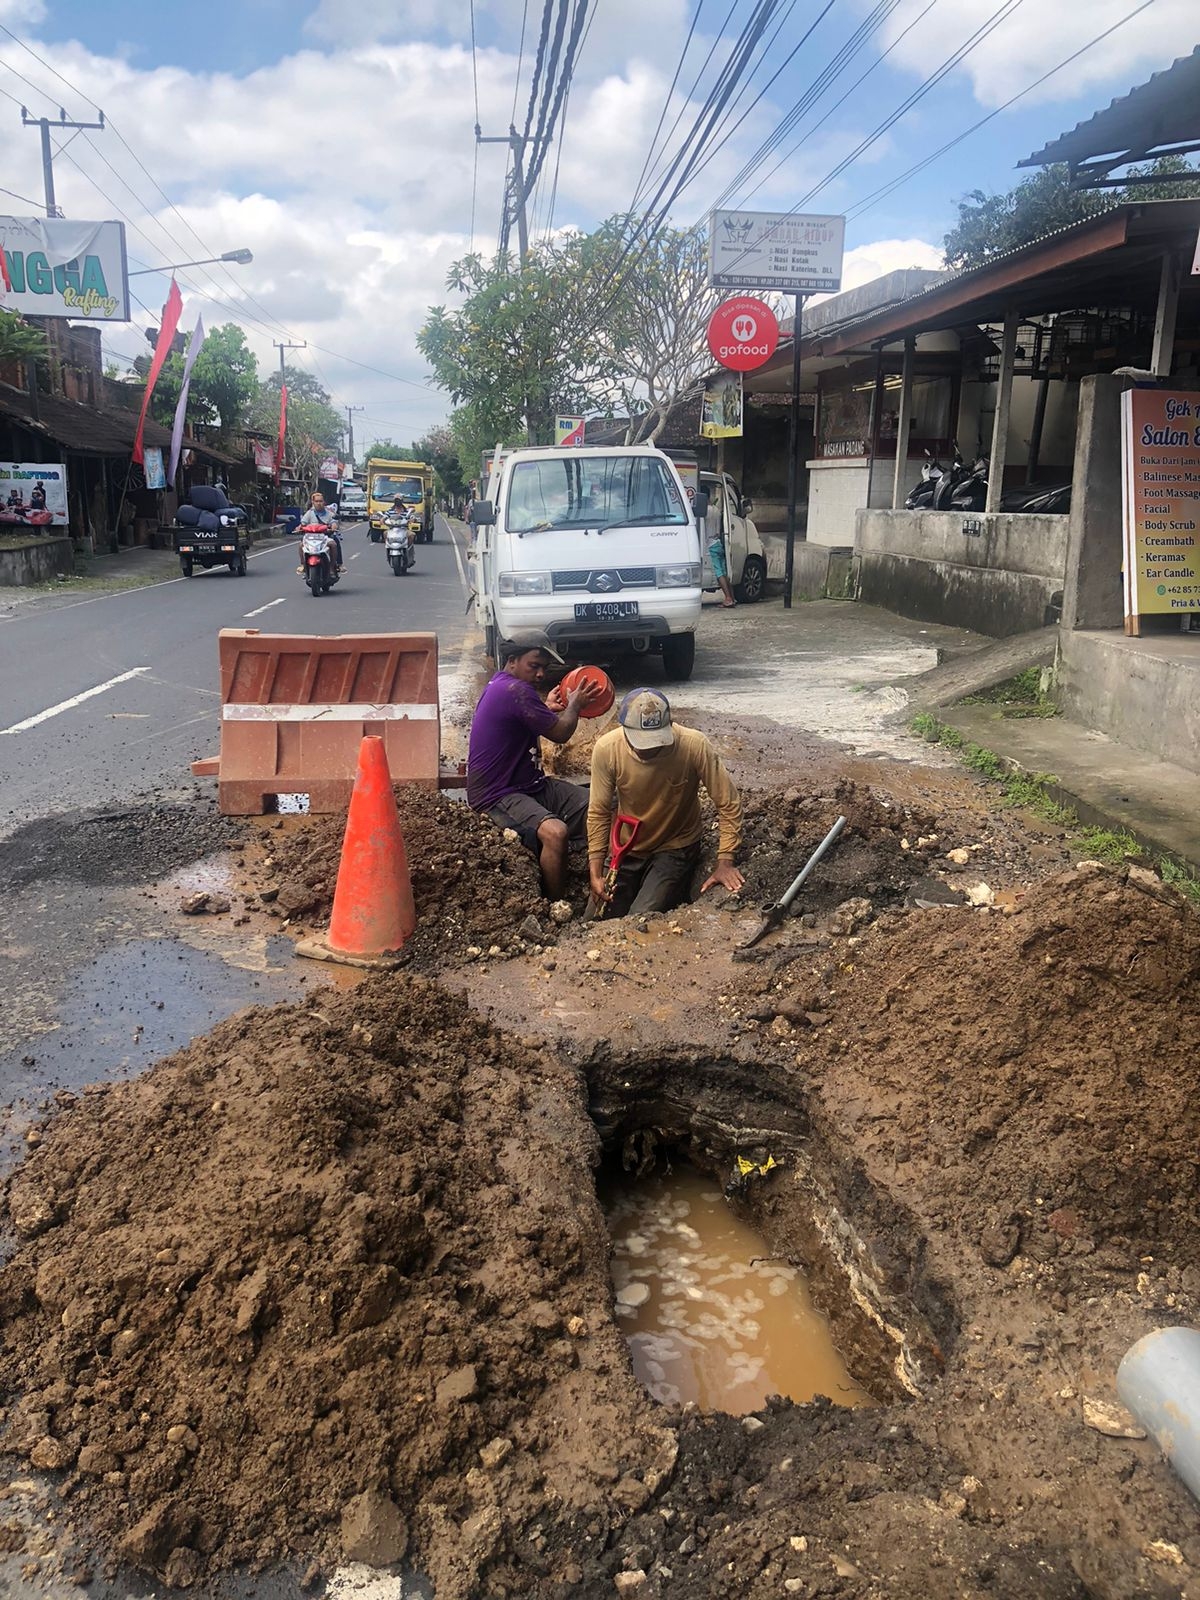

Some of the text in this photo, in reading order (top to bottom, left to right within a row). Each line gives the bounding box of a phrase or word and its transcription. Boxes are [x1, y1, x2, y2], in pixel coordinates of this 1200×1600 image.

[63, 285, 120, 317] Rafting
[735, 303, 761, 313] dipesan
[719, 343, 768, 359] gofood
[1165, 398, 1191, 420] Gek
[1141, 423, 1190, 446] Salon
[1140, 456, 1160, 464] Buka
[1162, 456, 1179, 465] Dari
[1143, 472, 1182, 481] Balinese
[1144, 488, 1163, 498] Foot
[1144, 504, 1170, 514] Facial
[1145, 520, 1196, 531] Body Scrub
[1145, 536, 1195, 546] Creambath
[1145, 552, 1186, 562] Keramas
[1146, 568, 1195, 578] Ear Candle
[1167, 585, 1181, 594] +62
[1182, 585, 1192, 594] 85
[1171, 599, 1188, 608] Pria
[1189, 599, 1196, 607] &
[575, 604, 587, 617] DK
[595, 603, 619, 616] 8408
